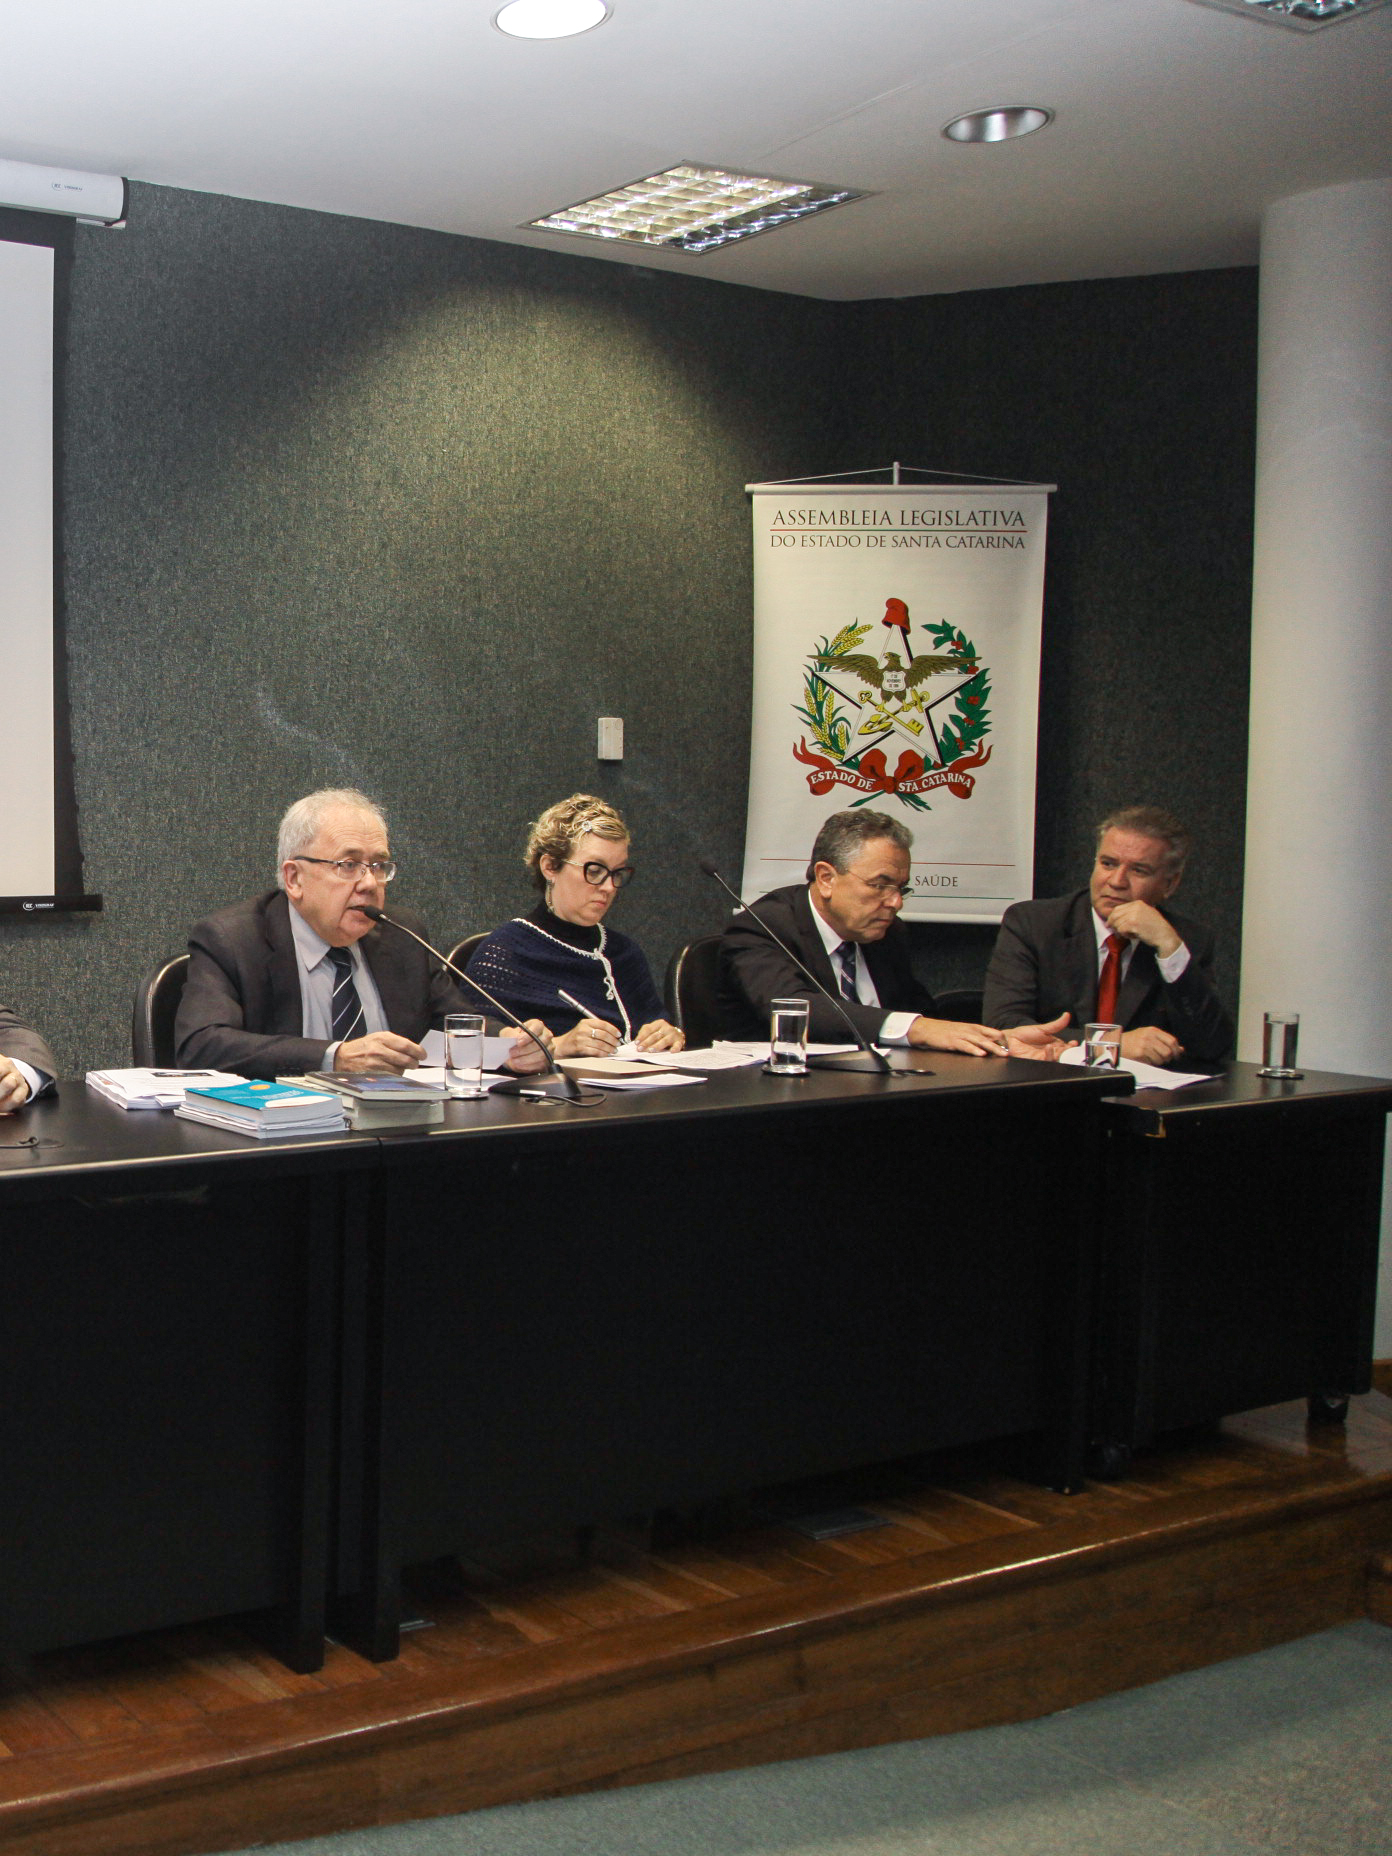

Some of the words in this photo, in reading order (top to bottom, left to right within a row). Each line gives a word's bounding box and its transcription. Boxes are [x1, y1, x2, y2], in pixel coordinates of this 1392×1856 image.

[772, 510, 893, 526] ASSEMBLEIA
[900, 510, 1026, 527] LEGISLATIVA
[771, 534, 796, 548] DO
[801, 535, 861, 548] ESTADO
[866, 535, 887, 548] DE
[891, 535, 942, 549] SANTA
[945, 535, 1026, 549] CATARINA
[810, 770, 856, 785] ESTADO
[858, 779, 873, 791] DE
[898, 783, 922, 793] STA.
[921, 772, 972, 789] CATARINA
[914, 873, 959, 888] SAÚDE
